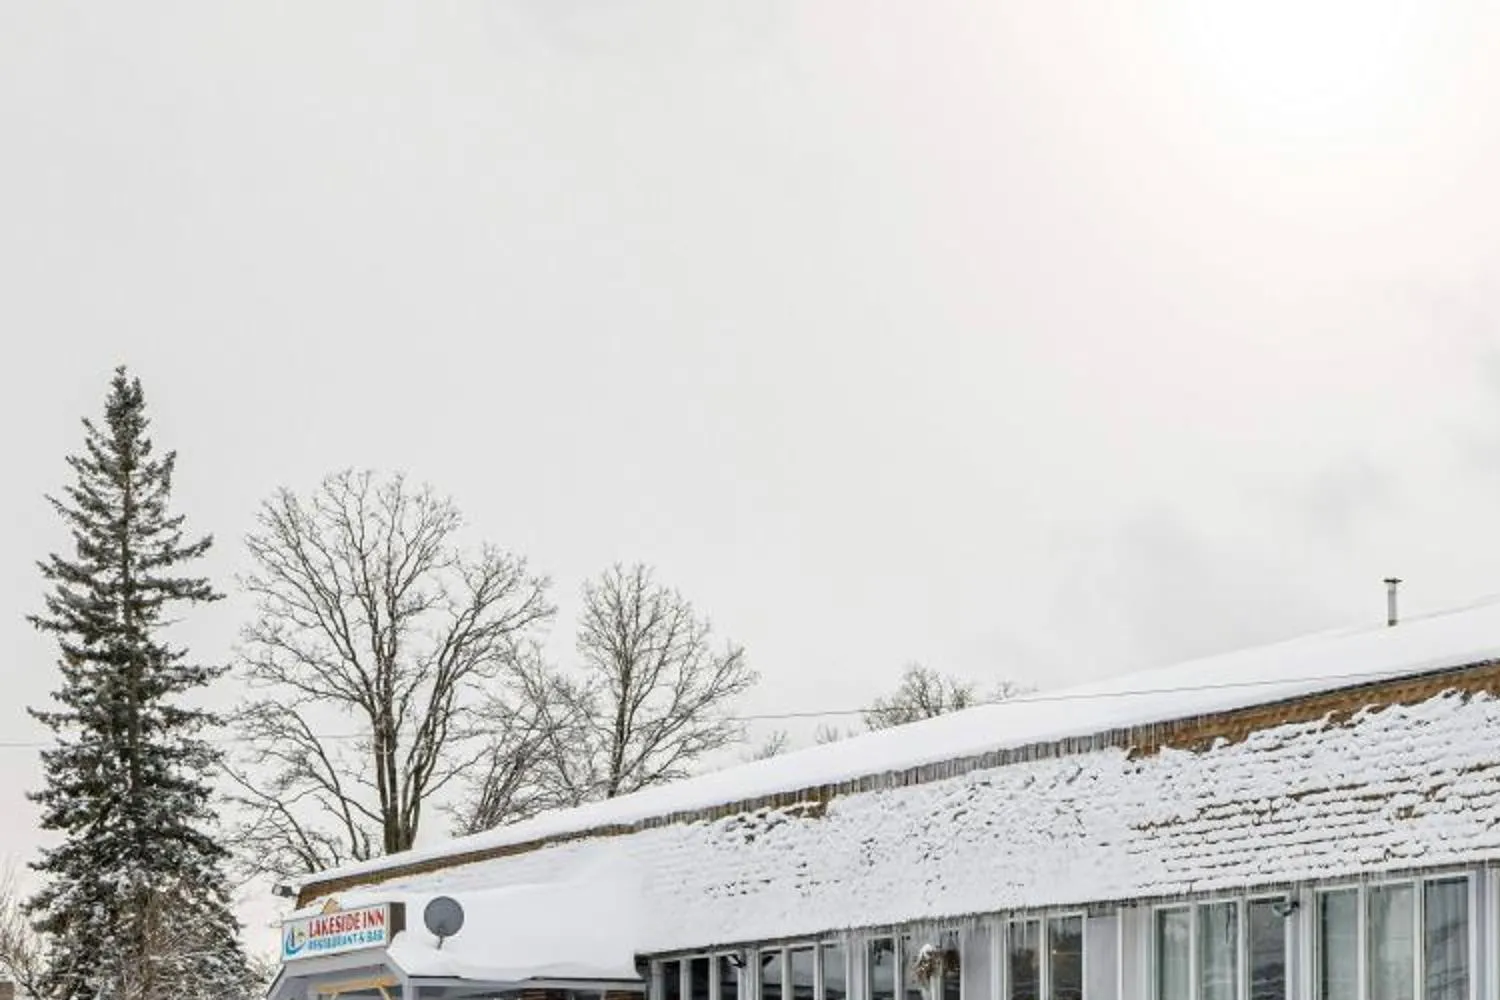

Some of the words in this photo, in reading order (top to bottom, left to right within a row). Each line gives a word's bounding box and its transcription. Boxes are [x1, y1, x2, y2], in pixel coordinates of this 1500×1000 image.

[308, 912, 361, 938] LAKESIDE
[363, 907, 385, 929] INN
[366, 930, 384, 943] BAR
